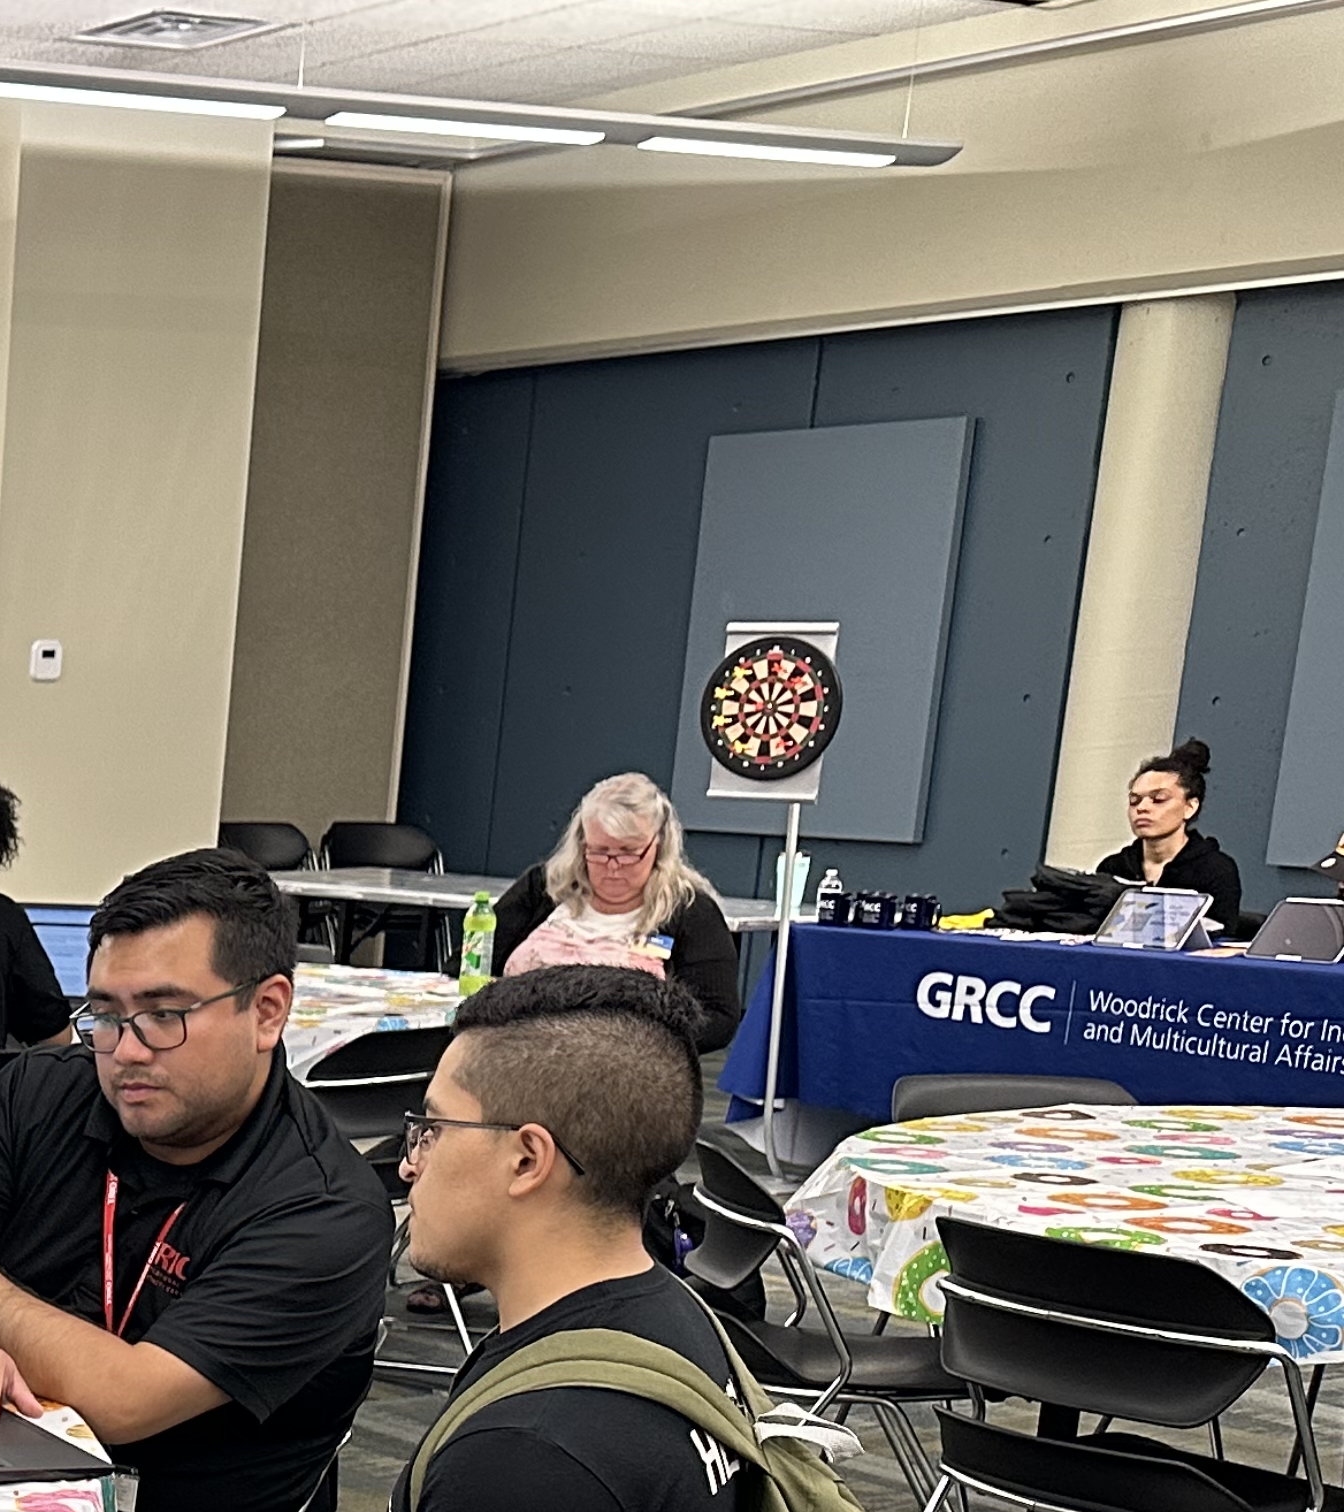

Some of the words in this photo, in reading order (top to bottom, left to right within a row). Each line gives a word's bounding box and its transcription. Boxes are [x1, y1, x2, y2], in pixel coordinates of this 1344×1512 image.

[917, 971, 1056, 1033] GRCC
[1089, 989, 1189, 1023] Woodrick
[1197, 1003, 1274, 1034] Center
[1280, 1012, 1315, 1039] for
[1320, 1018, 1344, 1044] In
[1083, 1021, 1124, 1044] and
[1130, 1023, 1270, 1064] Multicultural
